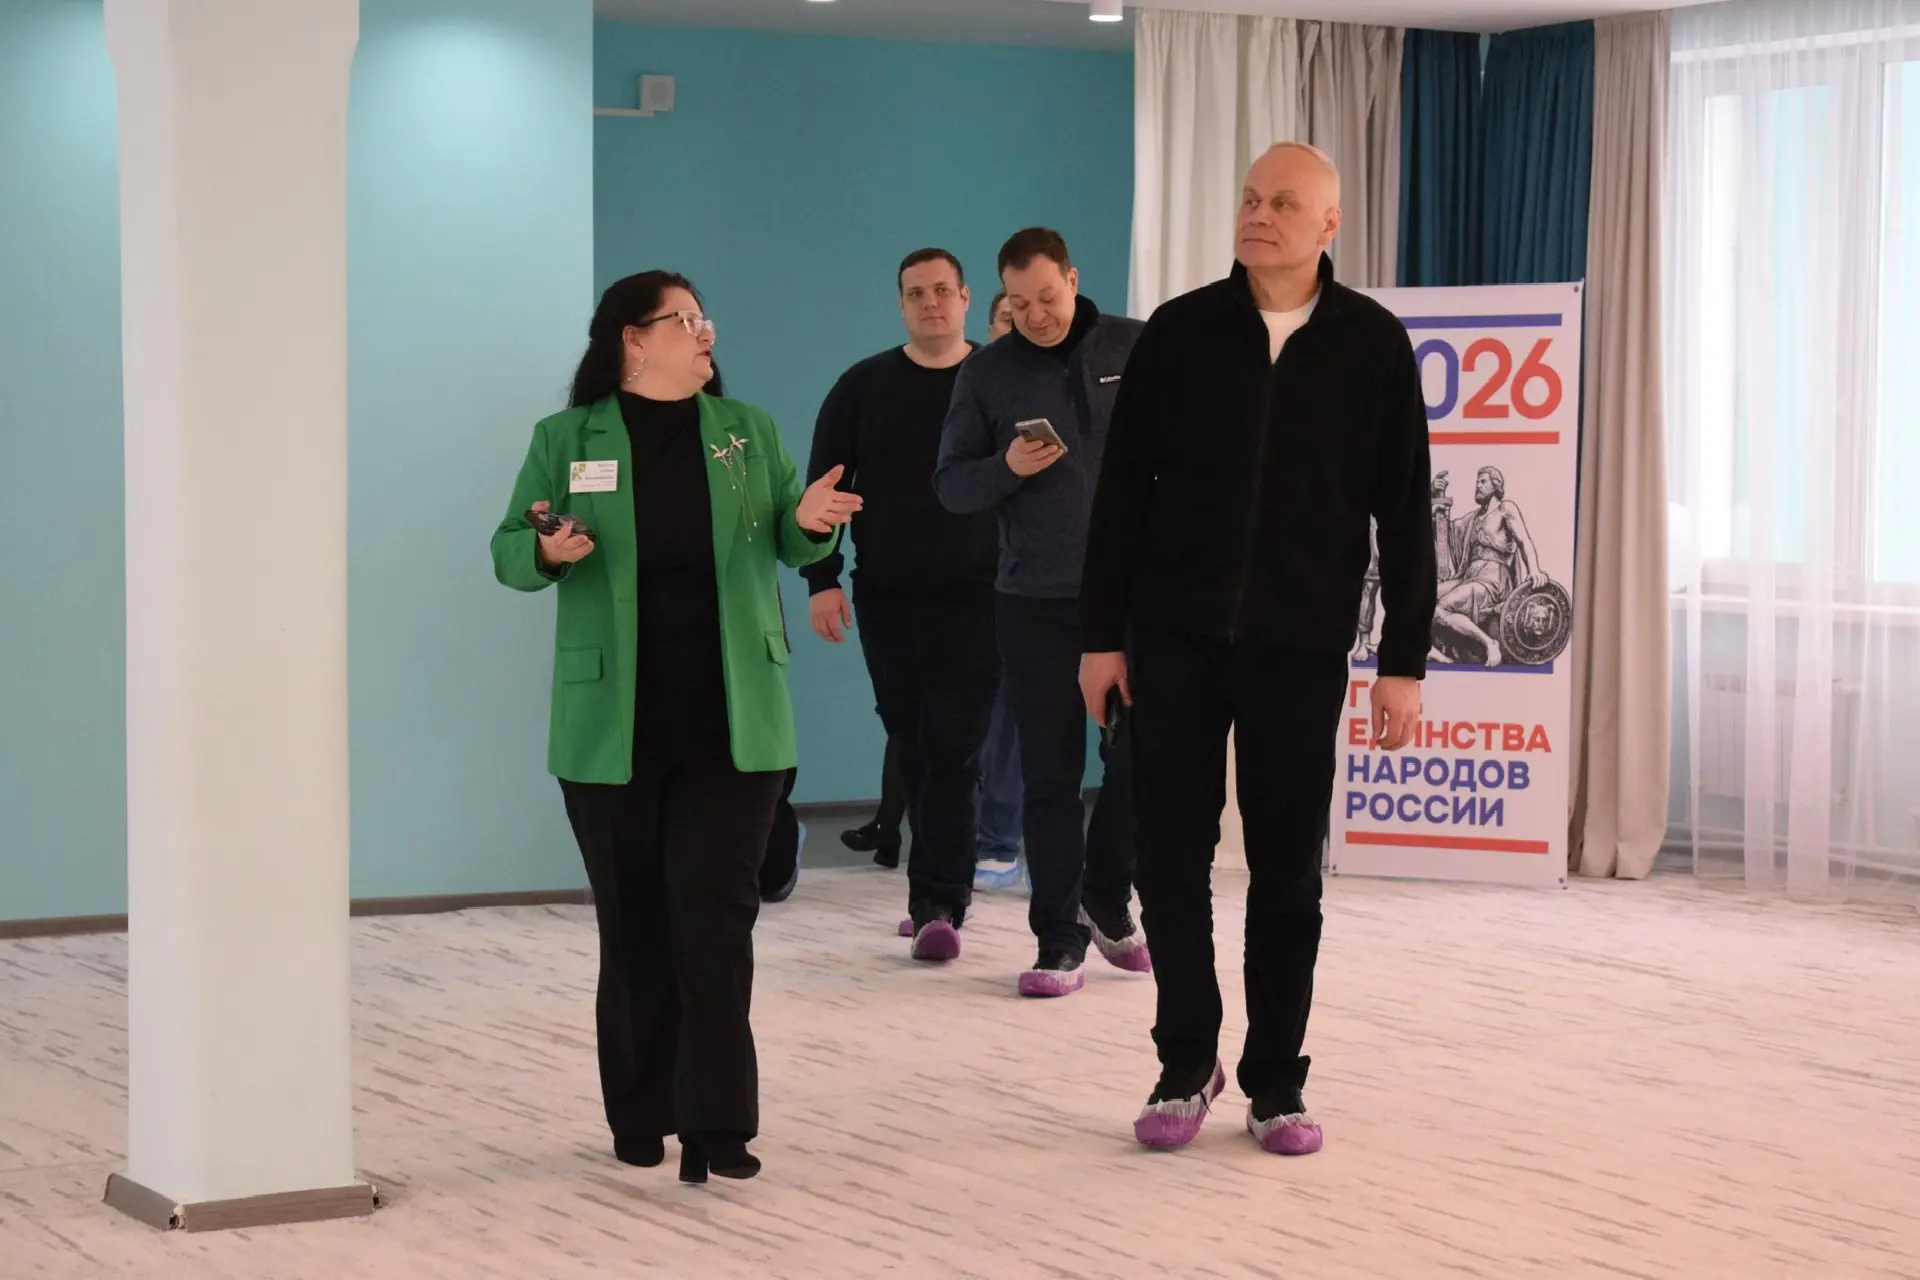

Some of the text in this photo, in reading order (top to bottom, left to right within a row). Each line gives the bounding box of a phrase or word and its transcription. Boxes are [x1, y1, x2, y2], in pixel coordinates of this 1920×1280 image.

[1415, 338, 1562, 420] 026
[1349, 718, 1552, 753] ЕНСТВА
[1347, 754, 1530, 792] НАРОДОВ
[1346, 791, 1504, 827] РОССИИ
